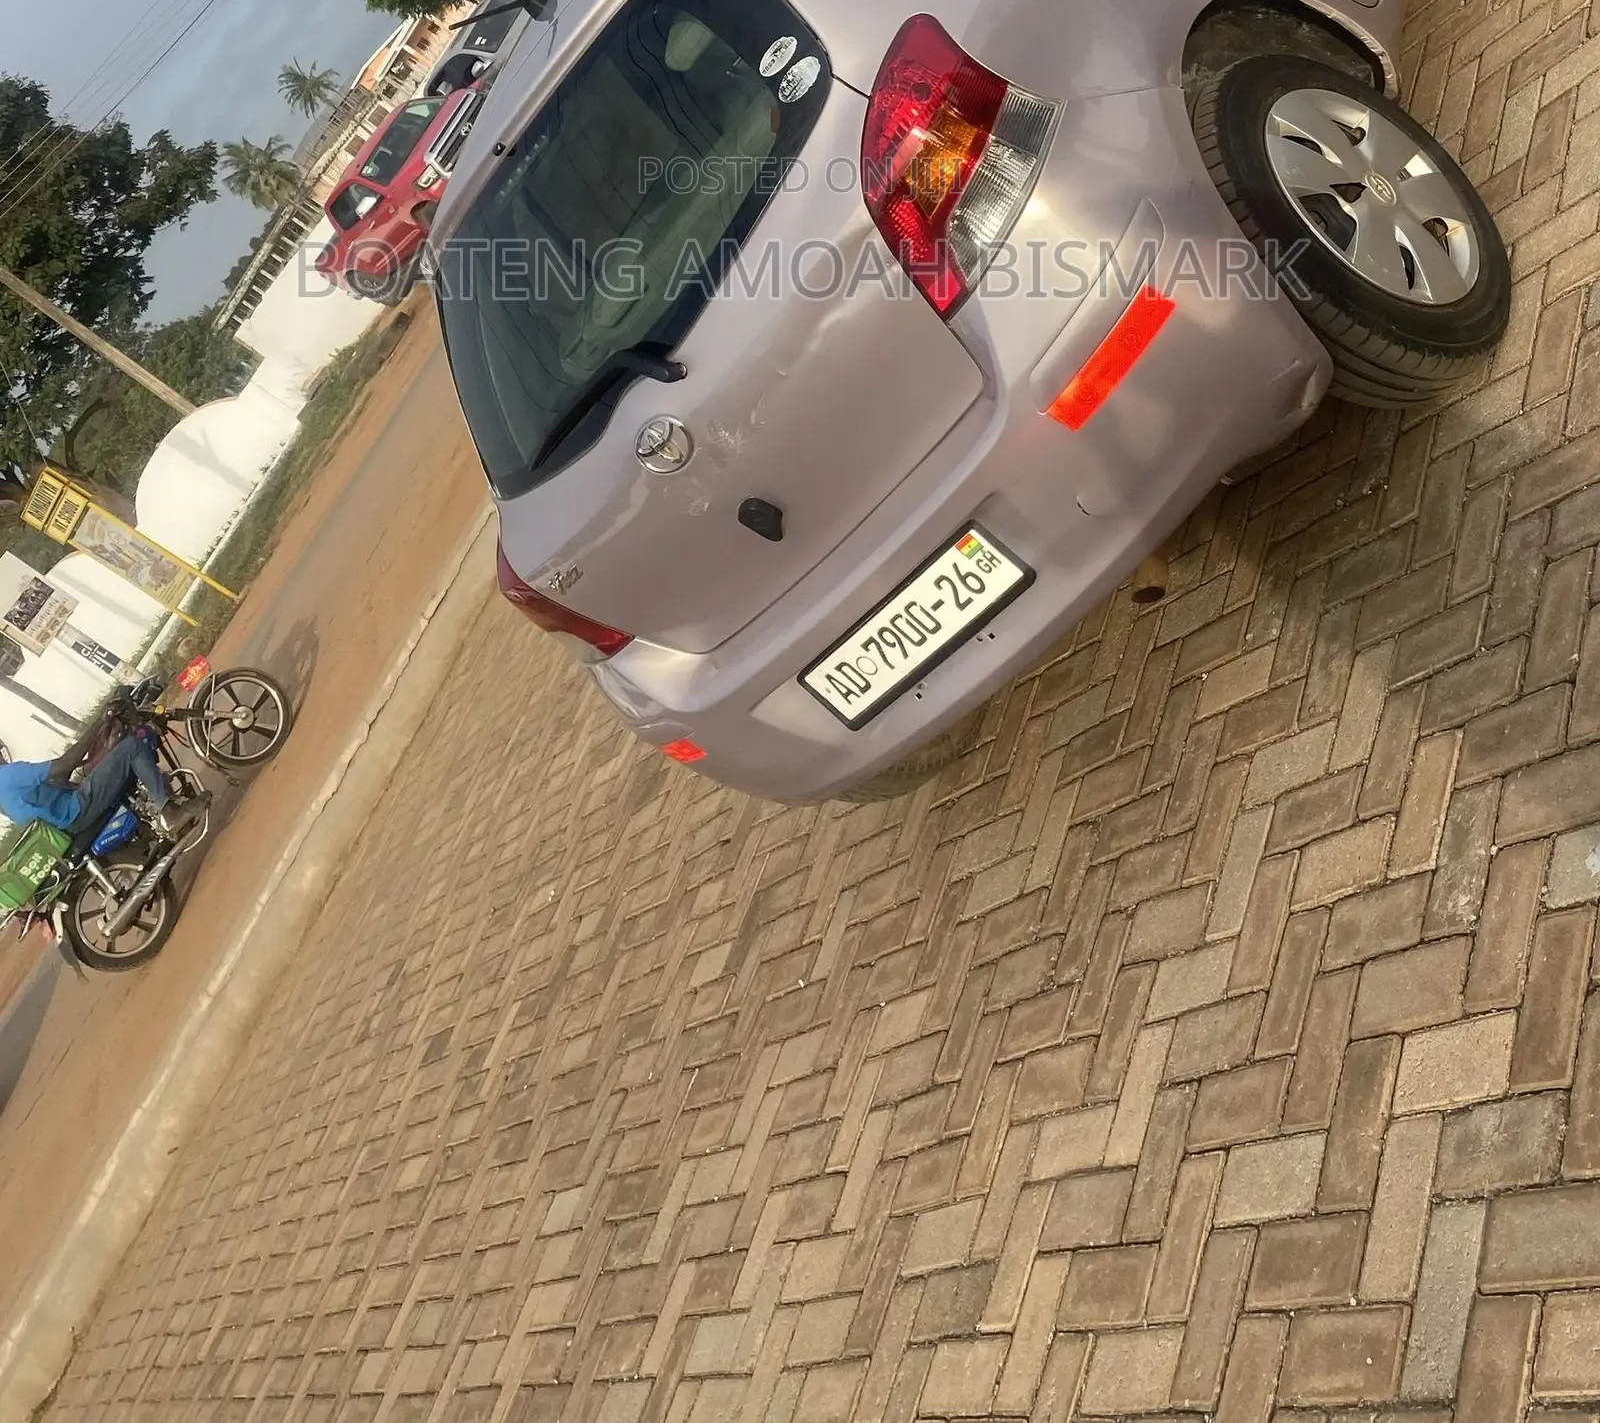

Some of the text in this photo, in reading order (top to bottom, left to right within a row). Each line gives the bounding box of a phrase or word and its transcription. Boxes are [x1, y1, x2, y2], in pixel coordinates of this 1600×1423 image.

[824, 549, 1003, 705] AD 7900-26 GH
[20, 852, 43, 877] Bolt
[29, 854, 57, 885] Food
